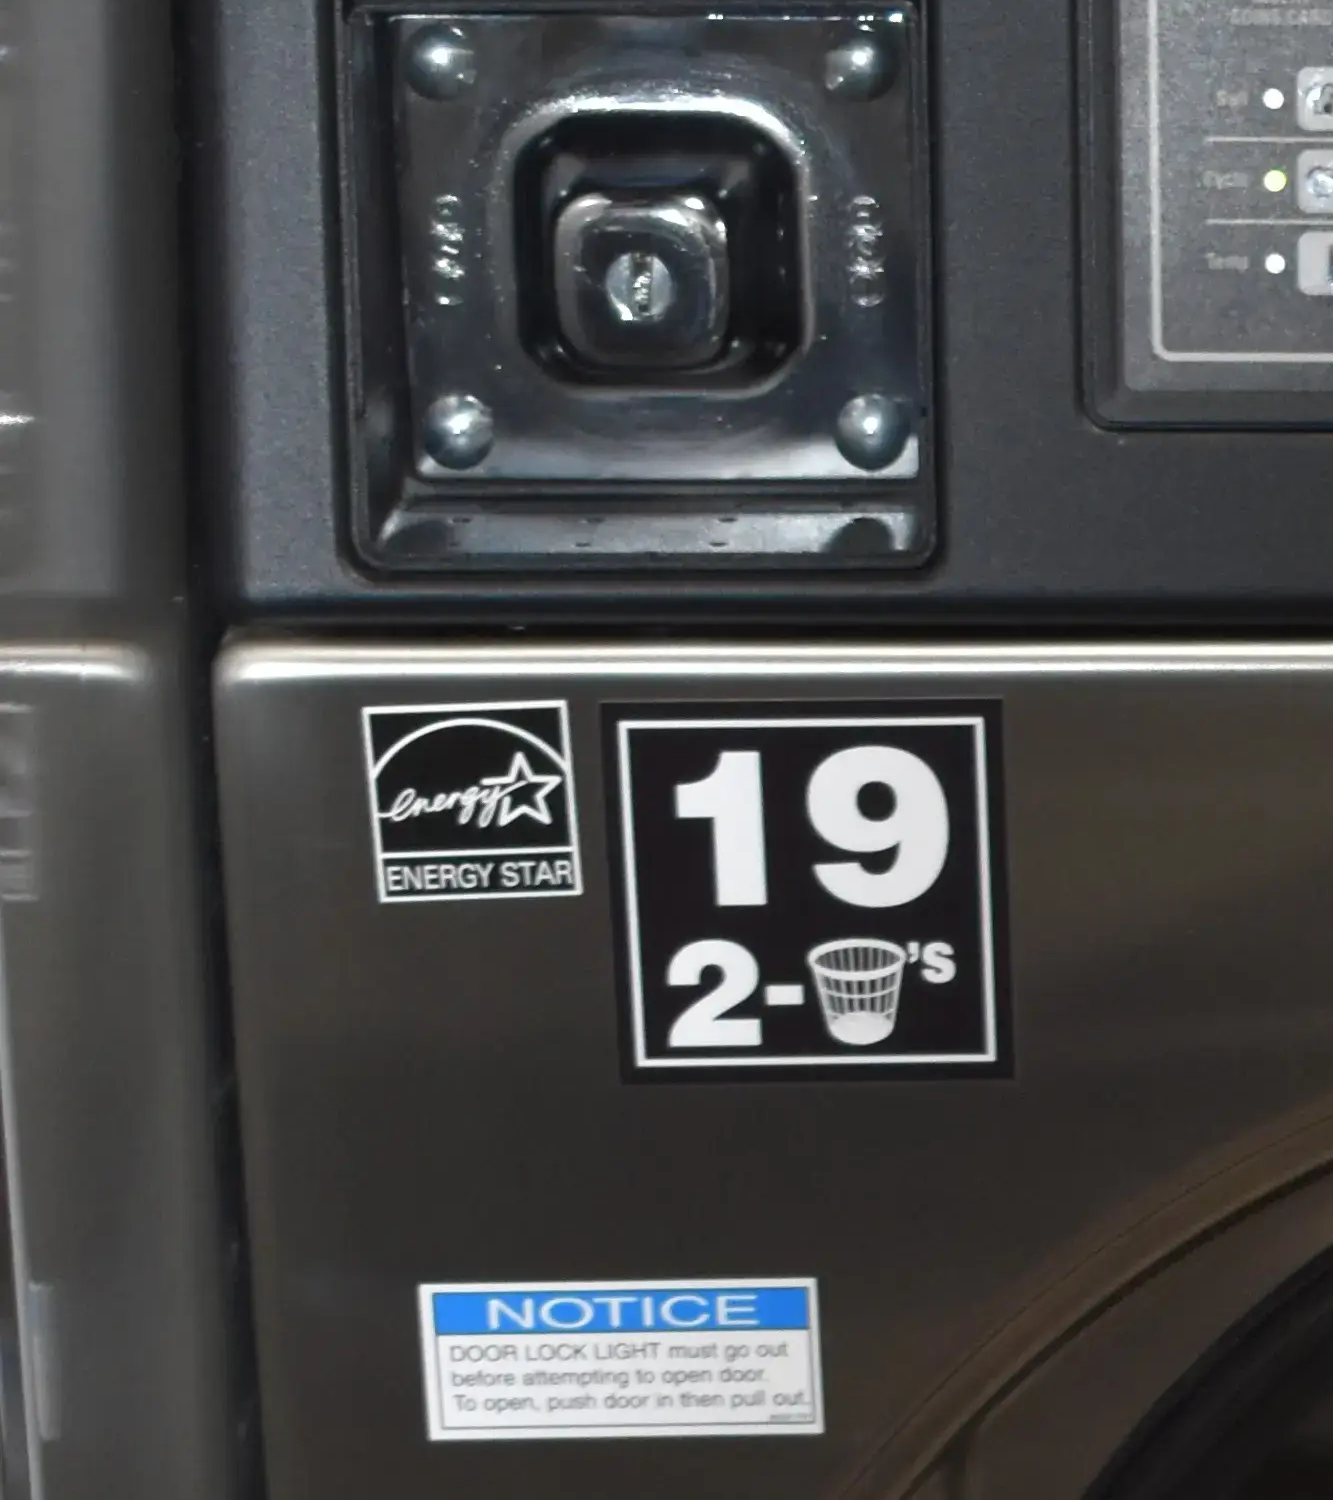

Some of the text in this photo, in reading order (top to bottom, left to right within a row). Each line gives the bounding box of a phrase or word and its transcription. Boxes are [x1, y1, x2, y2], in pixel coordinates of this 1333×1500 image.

[391, 777, 506, 829] energy
[675, 744, 949, 908] 19
[387, 860, 573, 891] ENERGY STAR
[487, 1295, 759, 1329] NOTICE
[450, 1342, 788, 1362] DOOR LOCK LIGHT must go out
[452, 1368, 764, 1389] before attempting to open door.
[453, 1394, 477, 1411] To
[547, 1394, 597, 1412] push
[604, 1390, 650, 1409] door
[656, 1394, 674, 1407] in
[679, 1392, 724, 1407] then
[731, 1390, 765, 1409] pull
